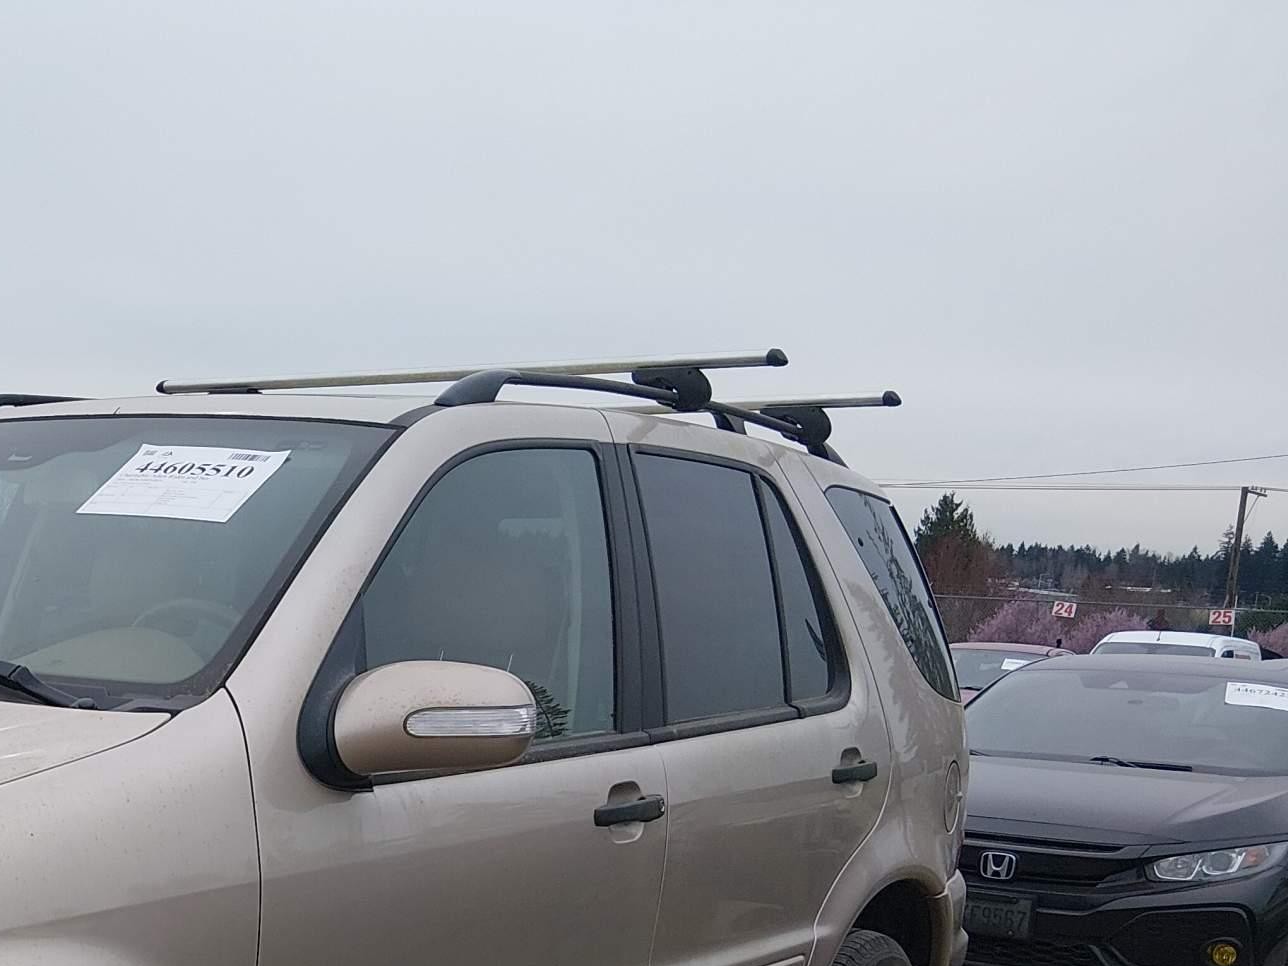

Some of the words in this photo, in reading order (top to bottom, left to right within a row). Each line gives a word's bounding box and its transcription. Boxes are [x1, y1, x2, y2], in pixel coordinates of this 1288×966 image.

[135, 460, 255, 479] 44605510
[1053, 602, 1074, 617] 24
[1211, 610, 1233, 625] 25
